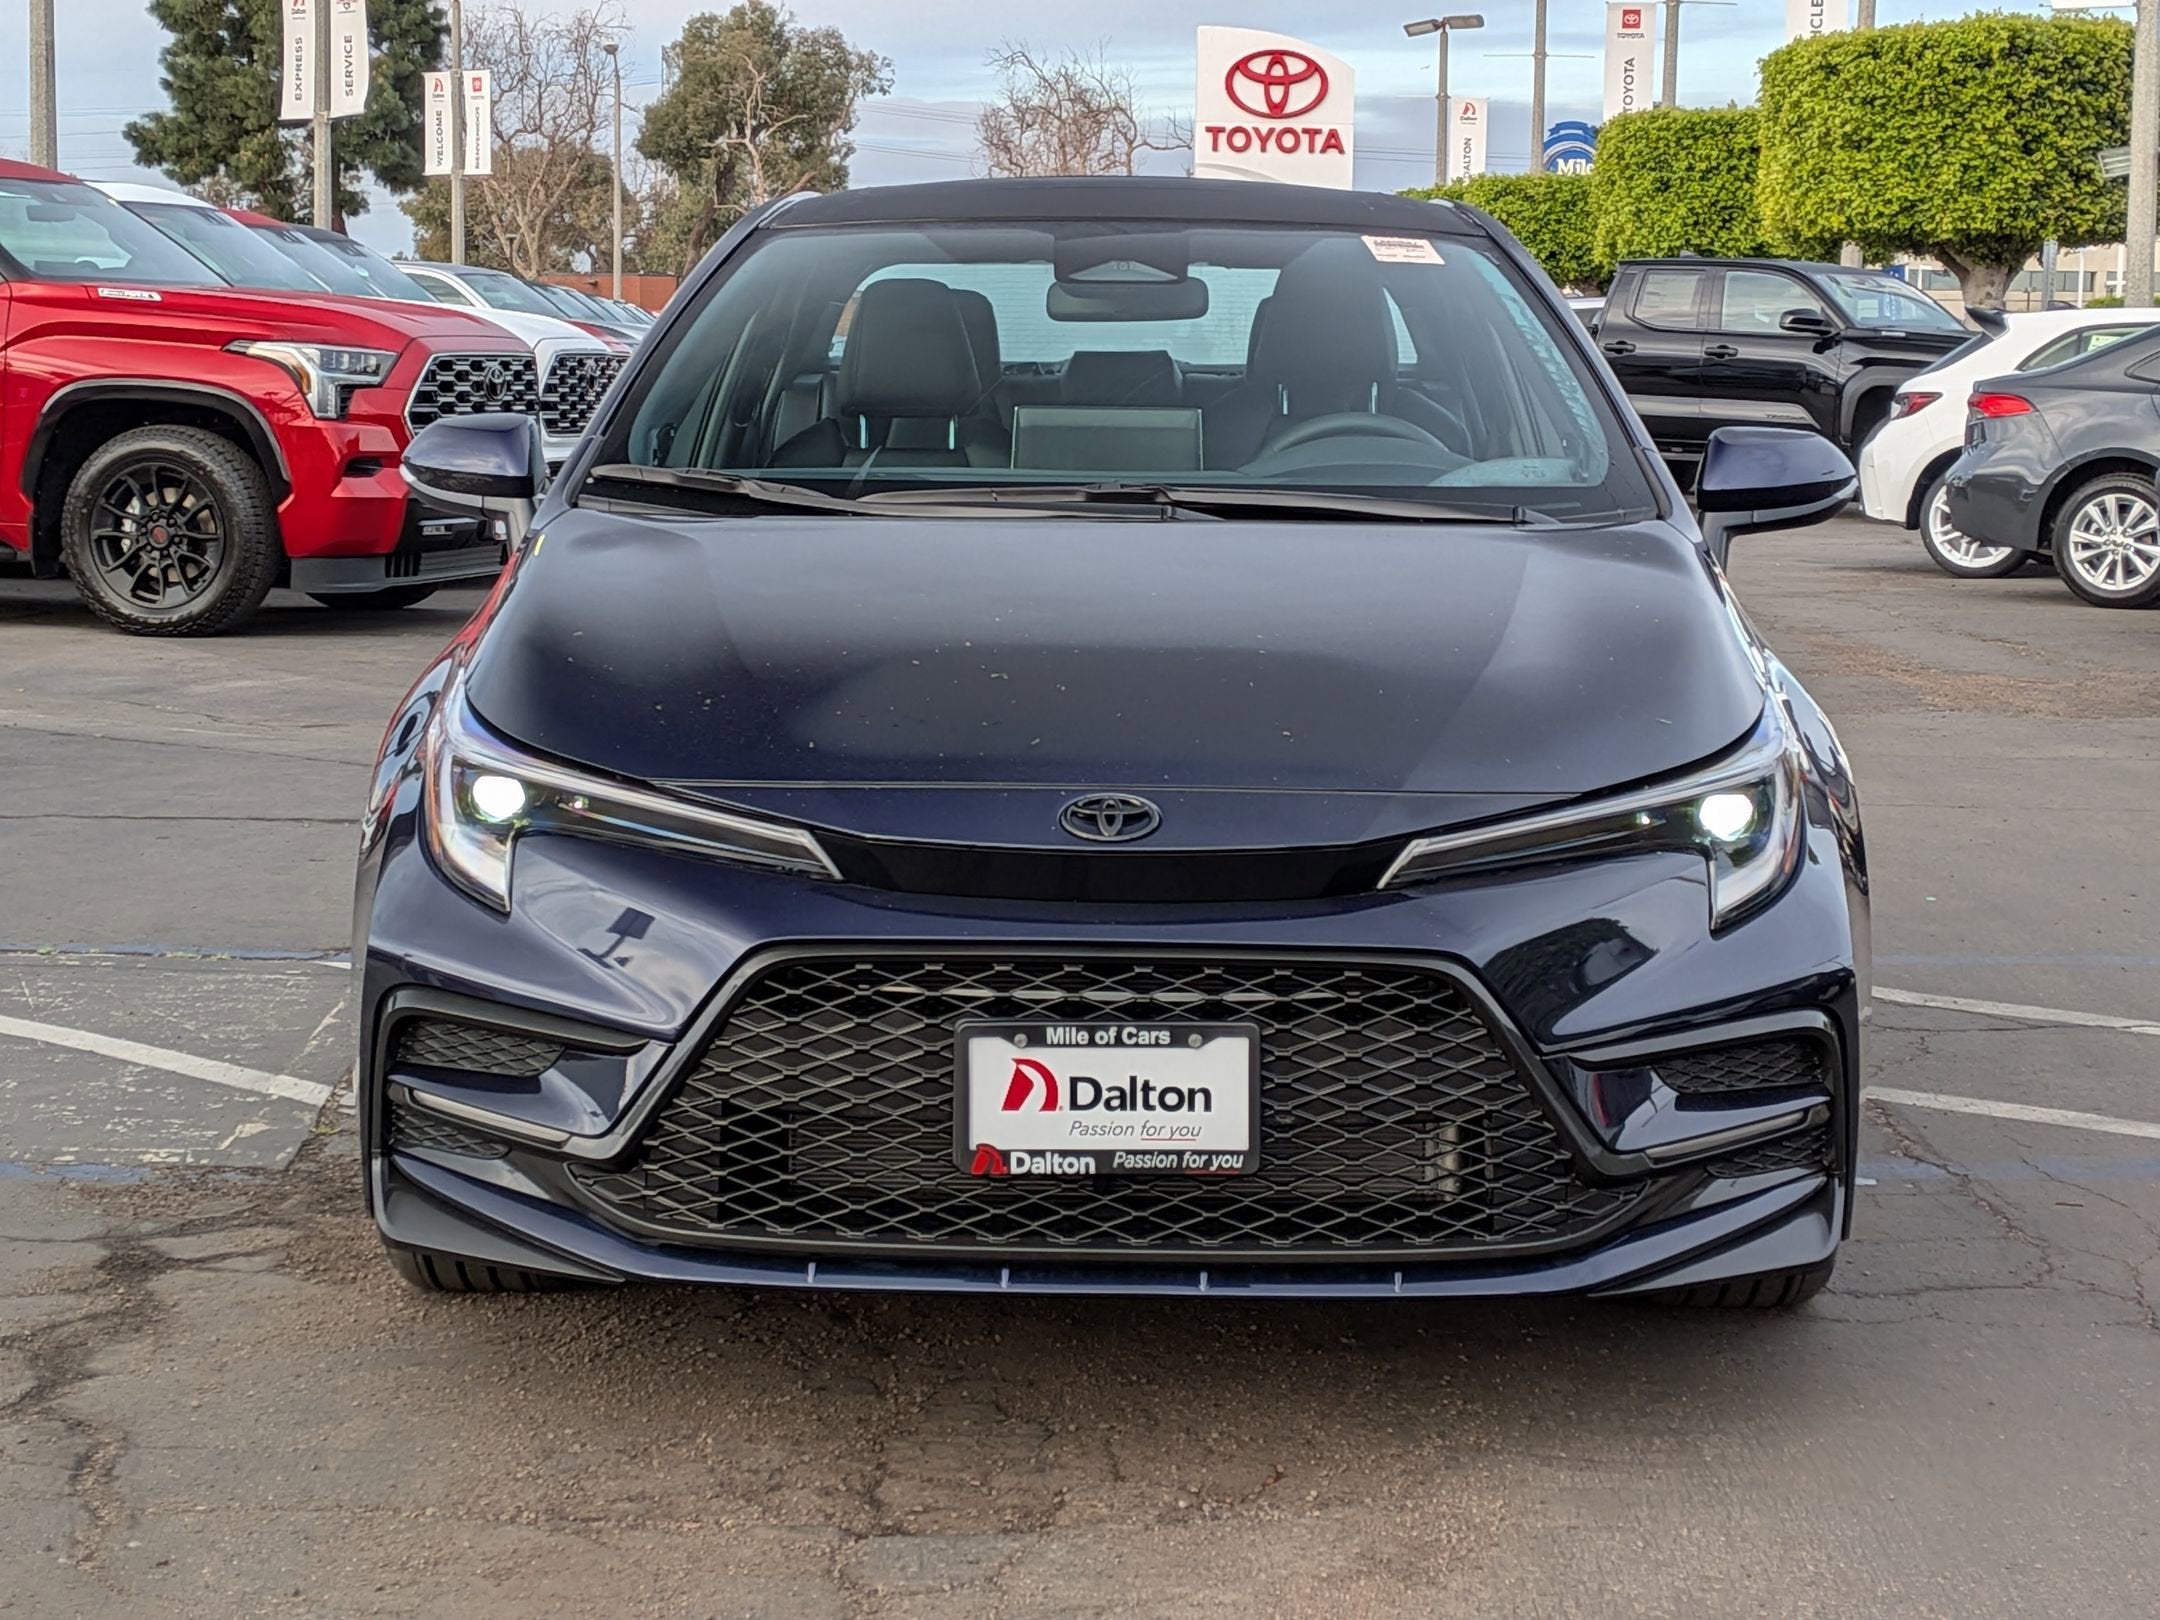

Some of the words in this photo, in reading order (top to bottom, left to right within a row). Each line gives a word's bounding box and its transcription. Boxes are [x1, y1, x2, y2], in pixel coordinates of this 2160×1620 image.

[295, 37, 303, 101] EXPRESS
[344, 35, 354, 97] SERVICE
[1623, 57, 1635, 114] TOYOTA
[436, 110, 444, 167] WELCOME
[1205, 126, 1346, 154] TOYOTA
[1463, 137, 1472, 180] DALTON
[1557, 157, 1594, 176] Mile
[1046, 1026, 1089, 1045] Mile
[1094, 1026, 1118, 1045] of
[1121, 1026, 1171, 1045] Cars
[1069, 1075, 1212, 1112] Dalton
[1069, 1120, 1135, 1136] Passion
[1140, 1120, 1166, 1137] for
[1165, 1124, 1202, 1141] you
[1010, 1152, 1096, 1175] Dalton
[1112, 1152, 1177, 1169] Passion
[1182, 1151, 1209, 1169] for
[1208, 1153, 1244, 1171] you
